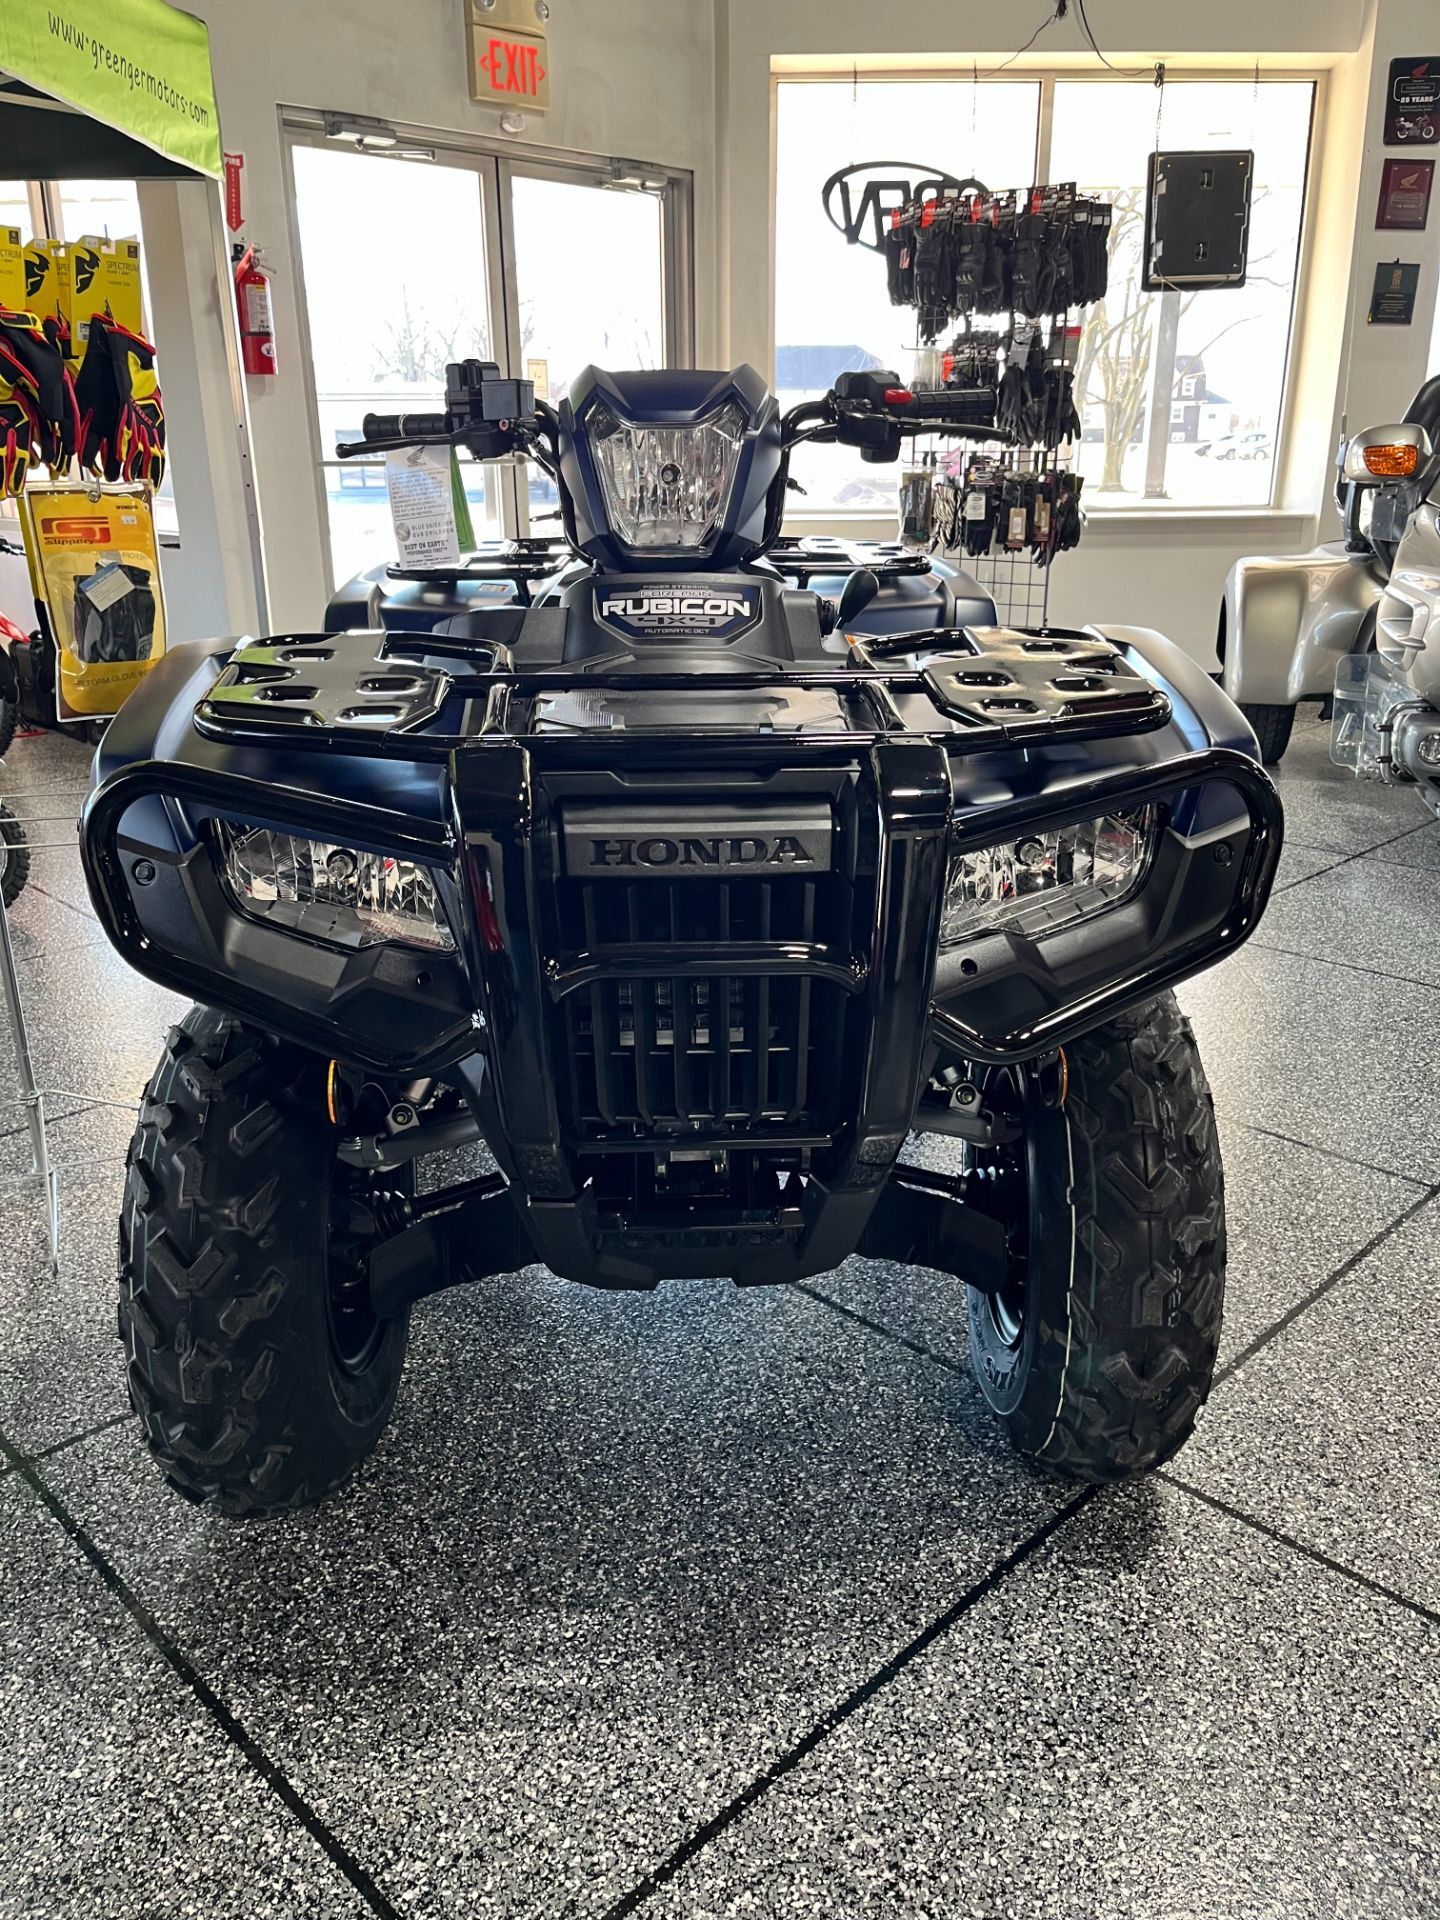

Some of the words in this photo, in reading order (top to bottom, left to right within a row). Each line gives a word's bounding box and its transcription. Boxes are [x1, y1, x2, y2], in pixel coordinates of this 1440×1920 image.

[48, 11, 209, 128] www.greengermotors.com
[488, 38, 538, 96] EXIT
[602, 598, 750, 617] RUBICON
[589, 836, 815, 867] HONDA
